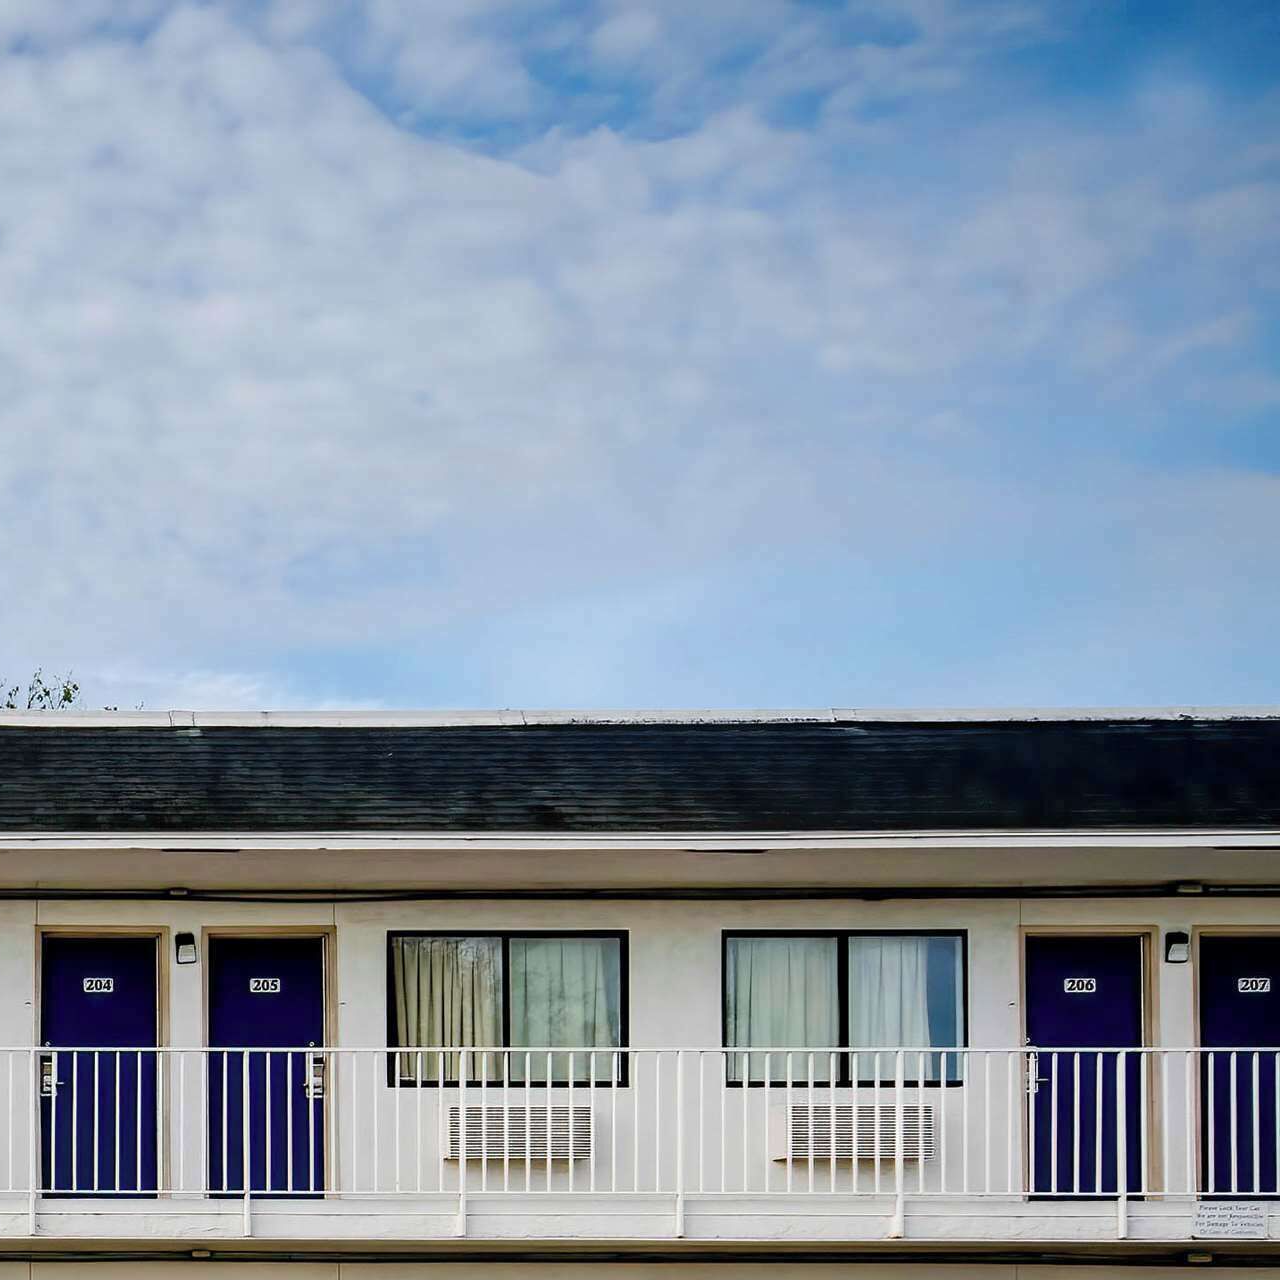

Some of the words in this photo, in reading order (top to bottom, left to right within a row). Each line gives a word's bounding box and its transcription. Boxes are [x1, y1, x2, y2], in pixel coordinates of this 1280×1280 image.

[86, 980, 112, 990] 204
[252, 980, 278, 991] 205
[1067, 980, 1094, 991] 206
[1240, 979, 1268, 990] 207
